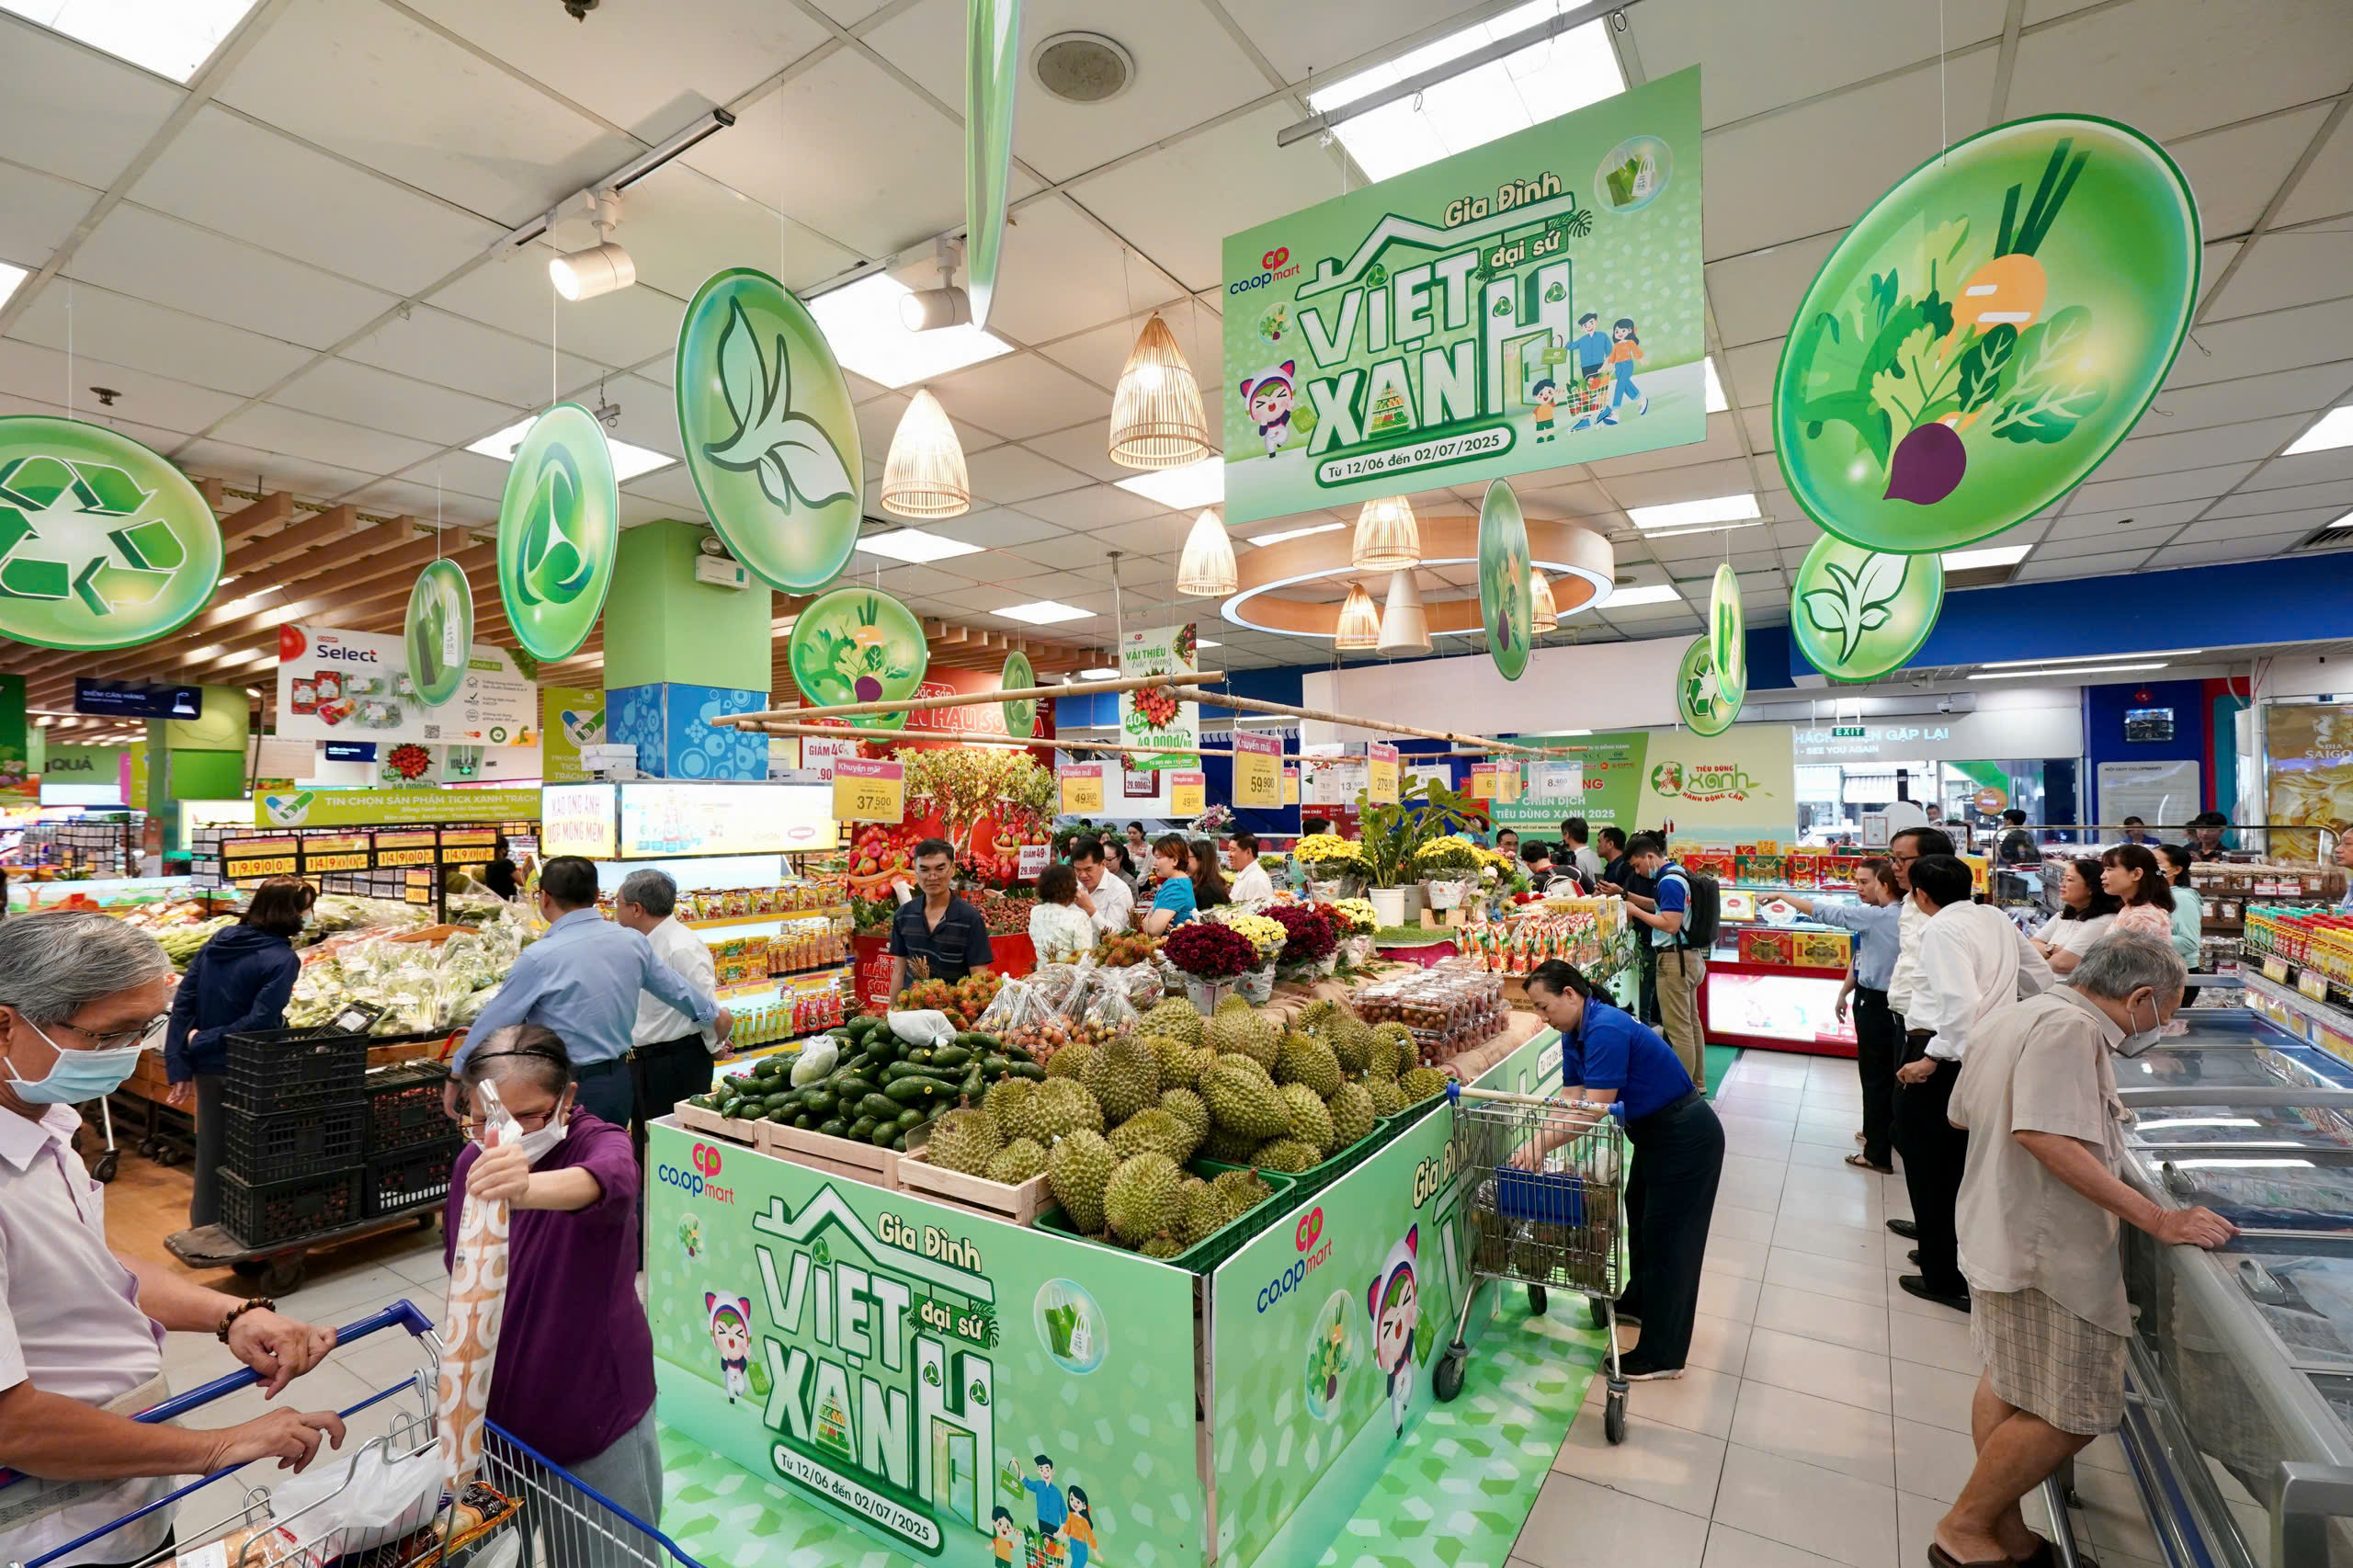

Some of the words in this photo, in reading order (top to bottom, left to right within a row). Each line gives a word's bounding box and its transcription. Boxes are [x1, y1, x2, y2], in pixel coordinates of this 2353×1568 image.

[1444, 195, 1488, 229] Gia
[1496, 171, 1563, 212] Đình
[1490, 238, 1527, 269] đại
[1532, 229, 1563, 258] sứ
[1307, 258, 1574, 457] XANH
[1328, 467, 1342, 478] Từ
[1347, 459, 1384, 474] 12/06
[1388, 453, 1411, 467] đến
[1414, 435, 1500, 461] 02/07/2025
[317, 645, 378, 663] Select
[1125, 650, 1141, 661] VẢI
[1126, 713, 1147, 727] 40%
[1795, 733, 1836, 744] HÁCH
[1886, 728, 1920, 742] GẶP
[1924, 728, 1949, 741] LẠI
[1836, 728, 1861, 736] EXIT
[809, 743, 830, 756] GIẢM
[1236, 738, 1259, 751] Khuyến
[2305, 750, 2352, 759] SAIGO
[837, 762, 866, 774] Khuyến
[1714, 764, 1734, 772] DÙNG
[1688, 764, 1751, 789] xanh
[348, 796, 383, 807] CHỌN
[449, 795, 471, 803] TICK
[506, 793, 538, 802] TRÁCH
[1682, 791, 1702, 801] HÀNH
[1495, 810, 1516, 819] TIÊU
[1519, 808, 1551, 819] DÙNG
[1553, 810, 1585, 819] XANH
[1588, 809, 1616, 818] 2025
[310, 857, 357, 869] 14.900
[381, 851, 424, 863] 14.900
[231, 860, 283, 873] 19.900
[1413, 1155, 1439, 1210] Gia
[878, 1211, 917, 1251] Gia
[924, 1224, 982, 1273] Đình
[920, 1299, 951, 1335] đại
[958, 1313, 983, 1341] sứ
[763, 1332, 997, 1536] XANH
[781, 1453, 793, 1471] Từ
[797, 1461, 829, 1489] 12/06
[832, 1480, 851, 1502] đến
[855, 1492, 929, 1541] 02/07/2025
